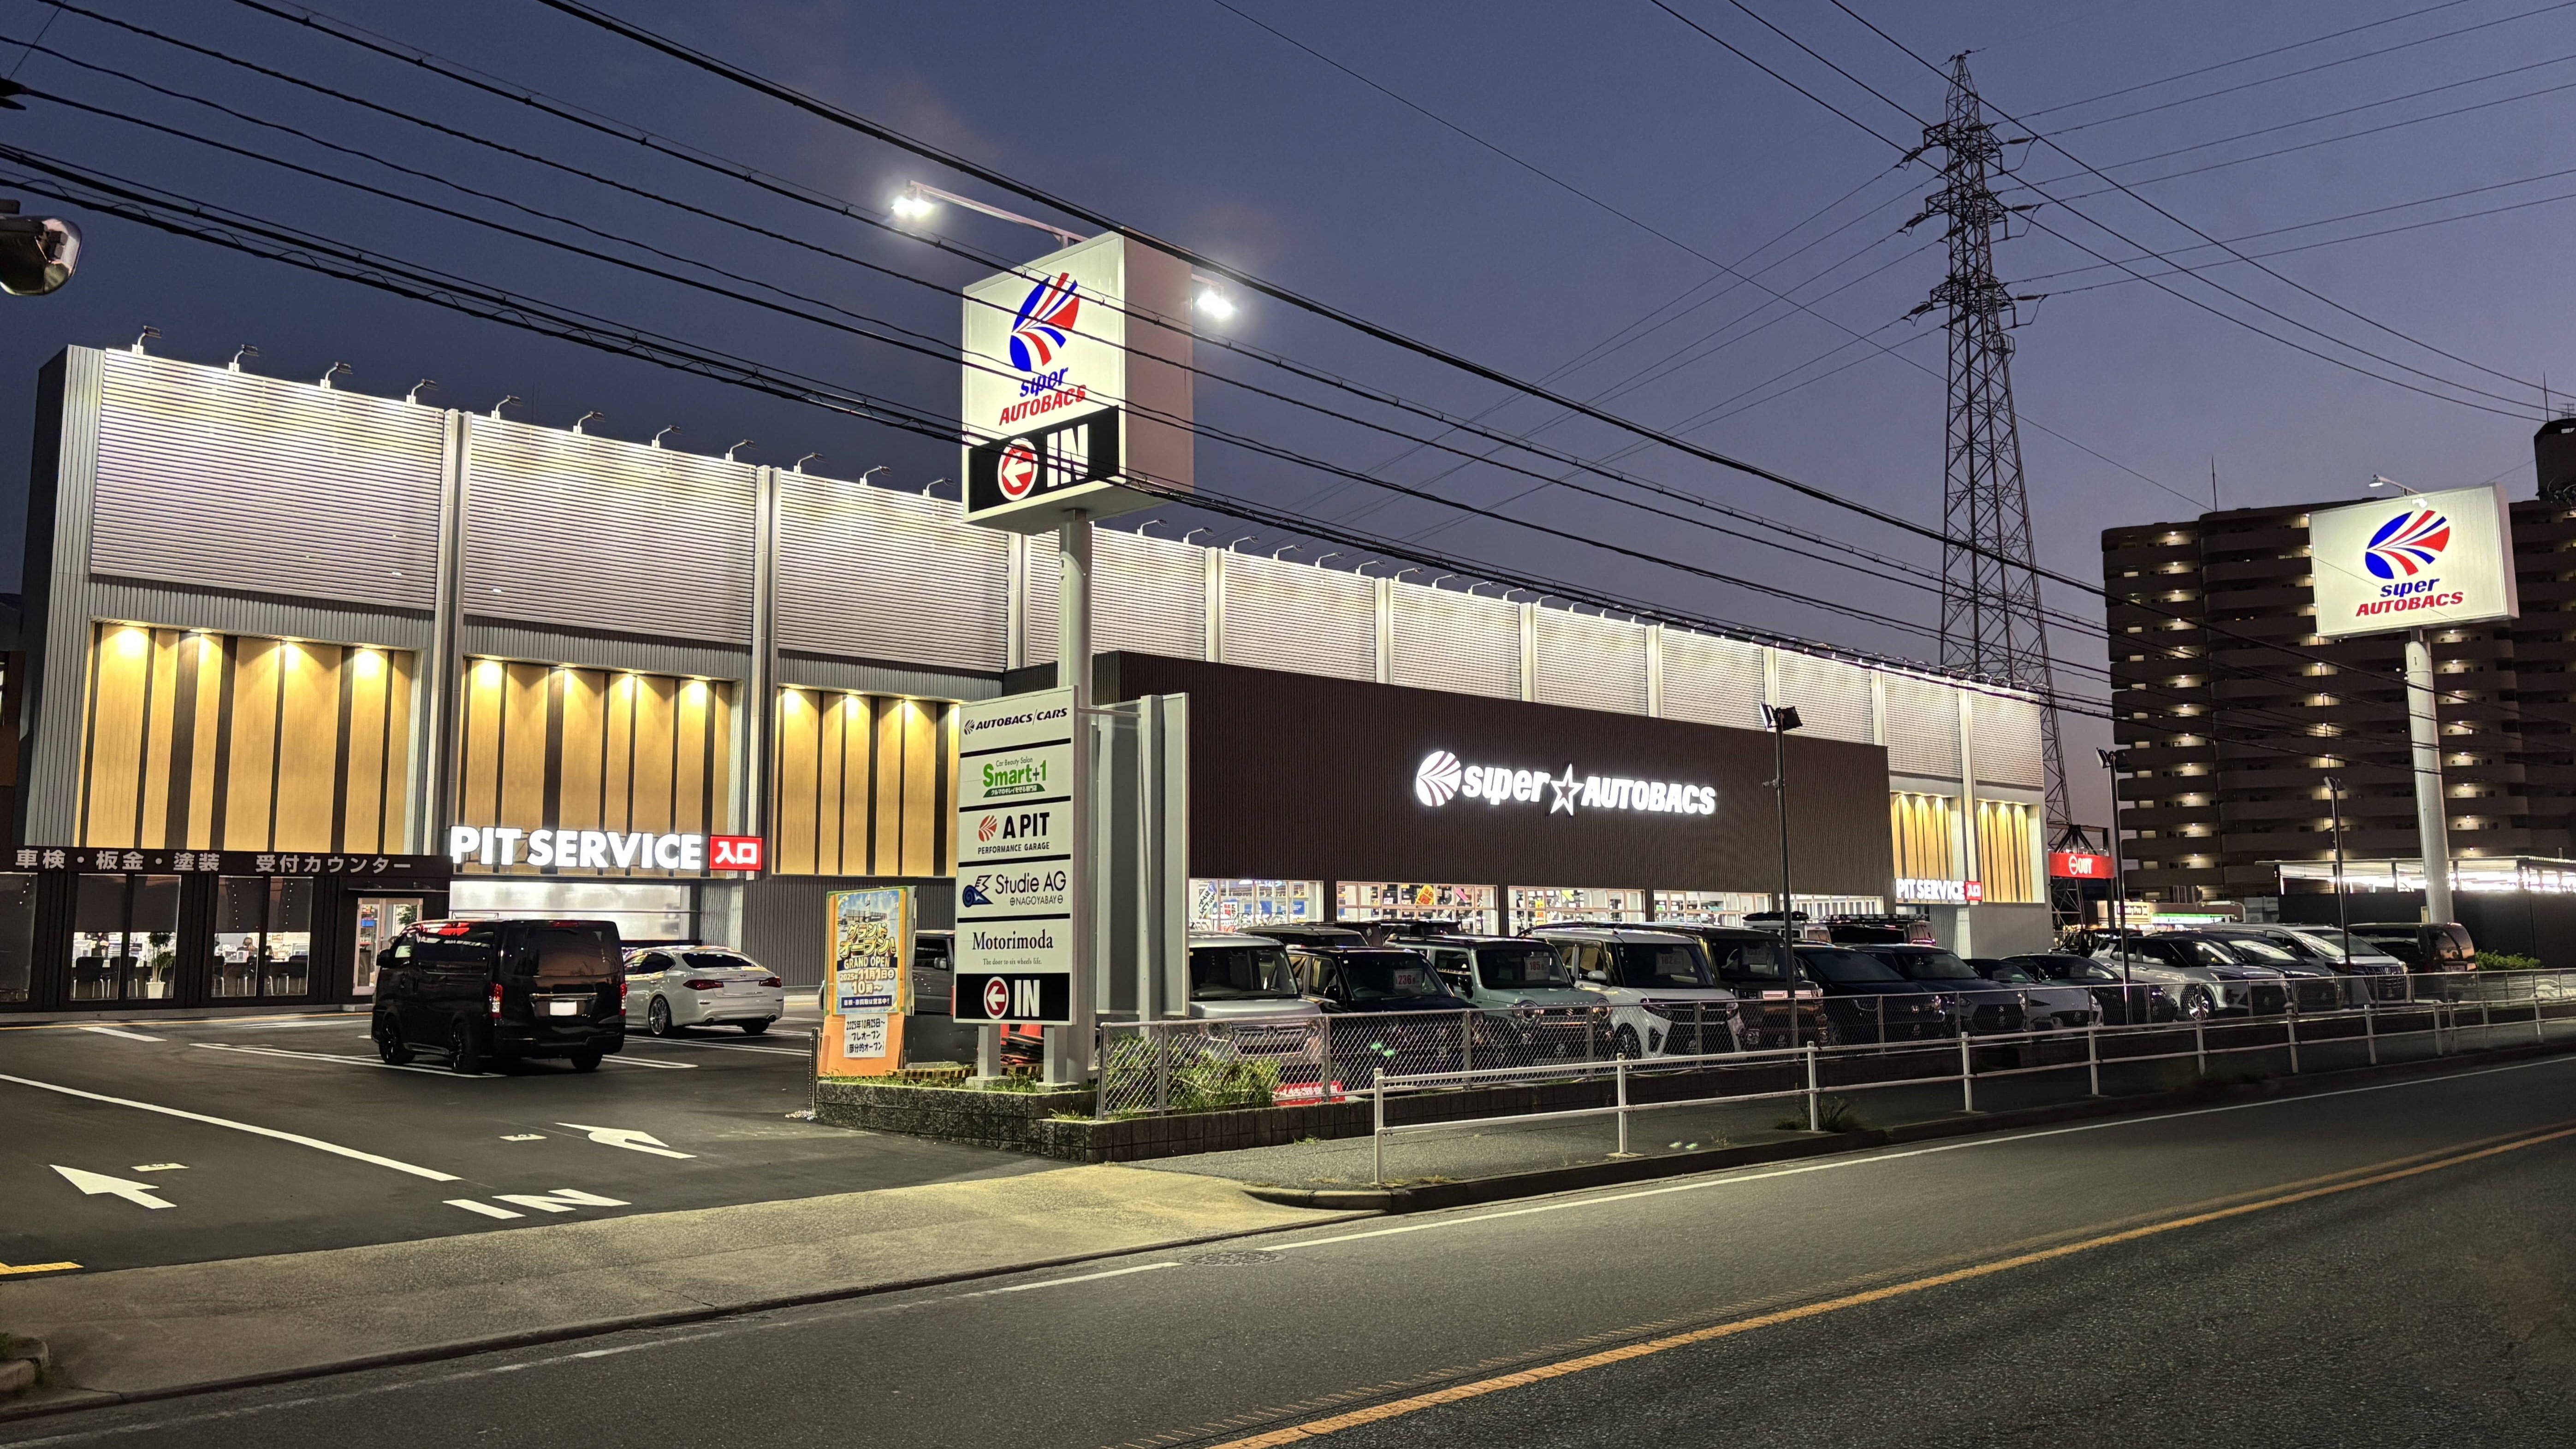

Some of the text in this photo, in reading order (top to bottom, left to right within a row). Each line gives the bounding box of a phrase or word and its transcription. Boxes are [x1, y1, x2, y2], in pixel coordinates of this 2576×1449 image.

[999, 385, 1086, 426] AUTOBACS
[1046, 423, 1088, 487] IN
[2380, 578, 2440, 597] super
[2356, 592, 2463, 617] AUTOBACS
[1580, 776, 1716, 815] AUTOBACS
[450, 826, 702, 870] PIT SERVICE
[714, 842, 757, 864] 入口
[978, 842, 1050, 855] PERFORMANCE GARAGE
[15, 850, 411, 873] 車検・板金・塗装 受付カウンター
[2077, 857, 2093, 874] OUT
[995, 870, 1066, 894] Studie AG
[1896, 878, 1965, 900] PIT SERVICE
[848, 922, 887, 940] グランド
[972, 928, 1053, 950] Motorimoda
[844, 956, 890, 969] GRAND OPEN
[1014, 980, 1040, 1017] IN
[442, 1188, 632, 1219] IN
